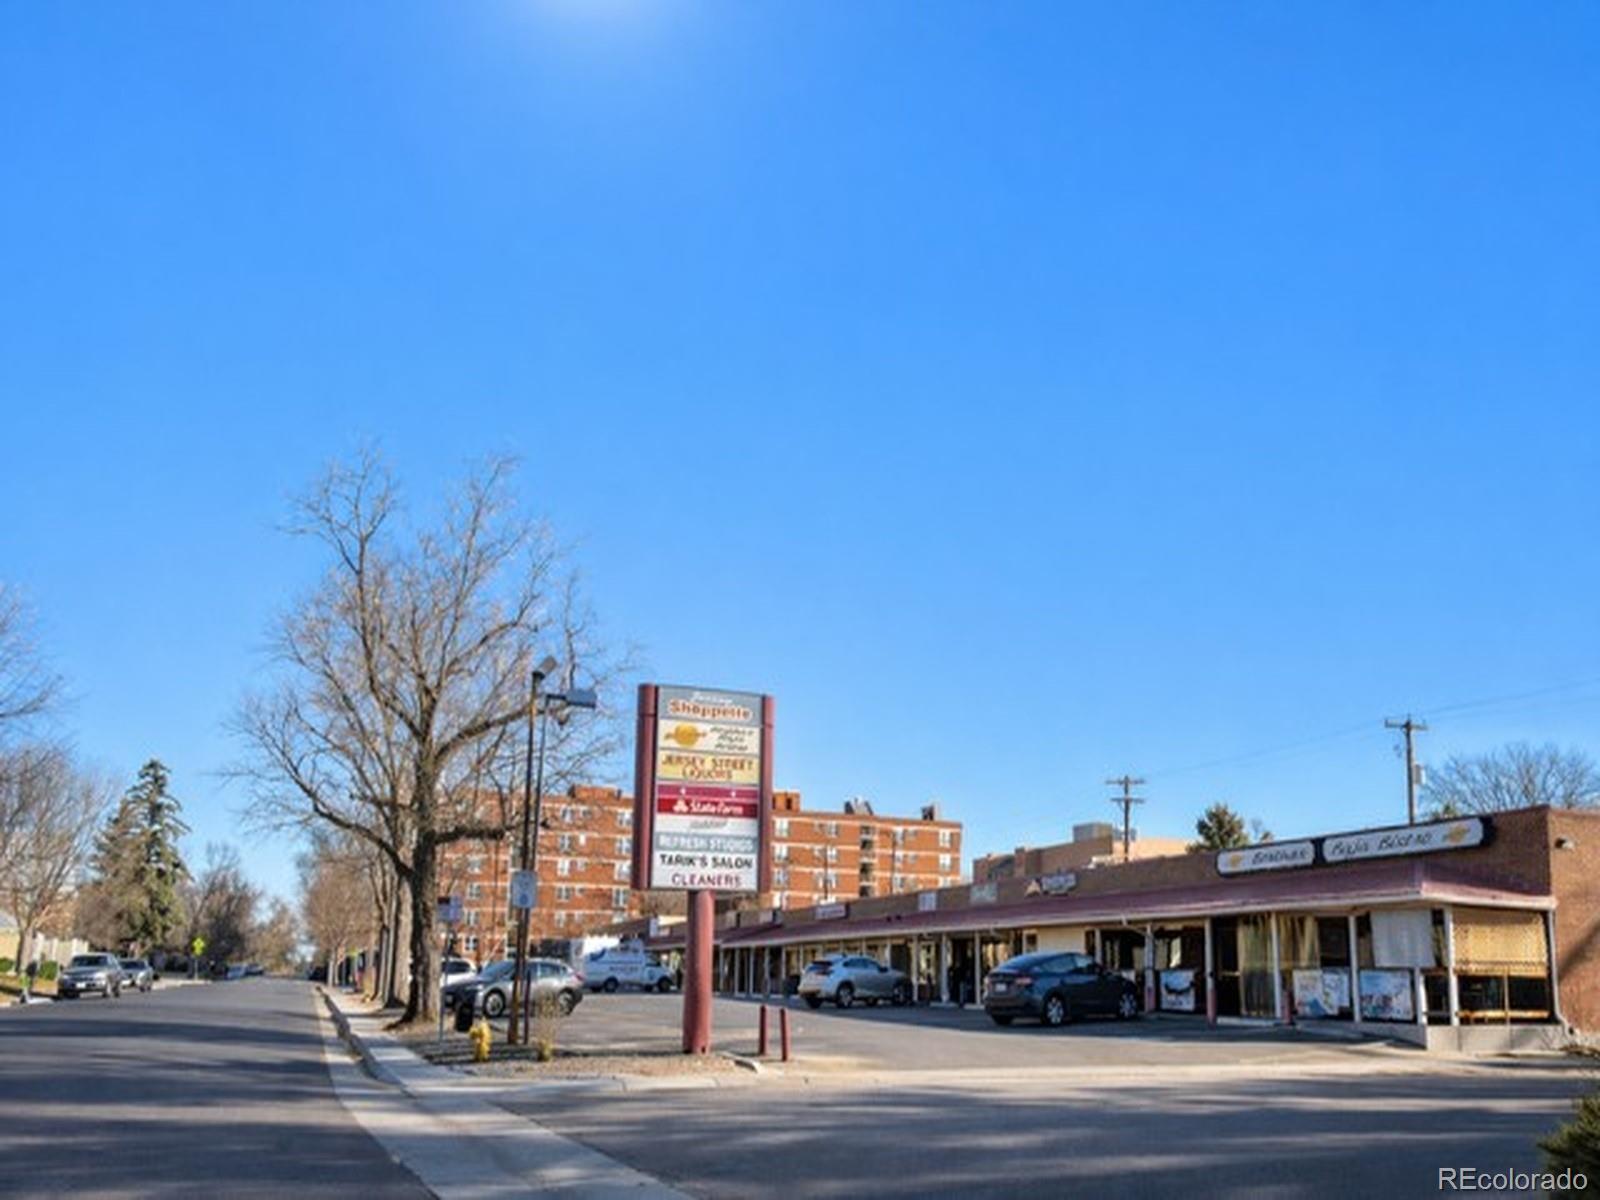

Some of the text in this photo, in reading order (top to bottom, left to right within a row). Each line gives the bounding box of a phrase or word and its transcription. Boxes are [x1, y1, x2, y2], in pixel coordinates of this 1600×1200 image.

[668, 699, 752, 720] Shoppette
[661, 754, 753, 771] JERSEY STREET
[660, 853, 754, 869] TARIK'S SALON
[671, 873, 742, 887] CLEANERS
